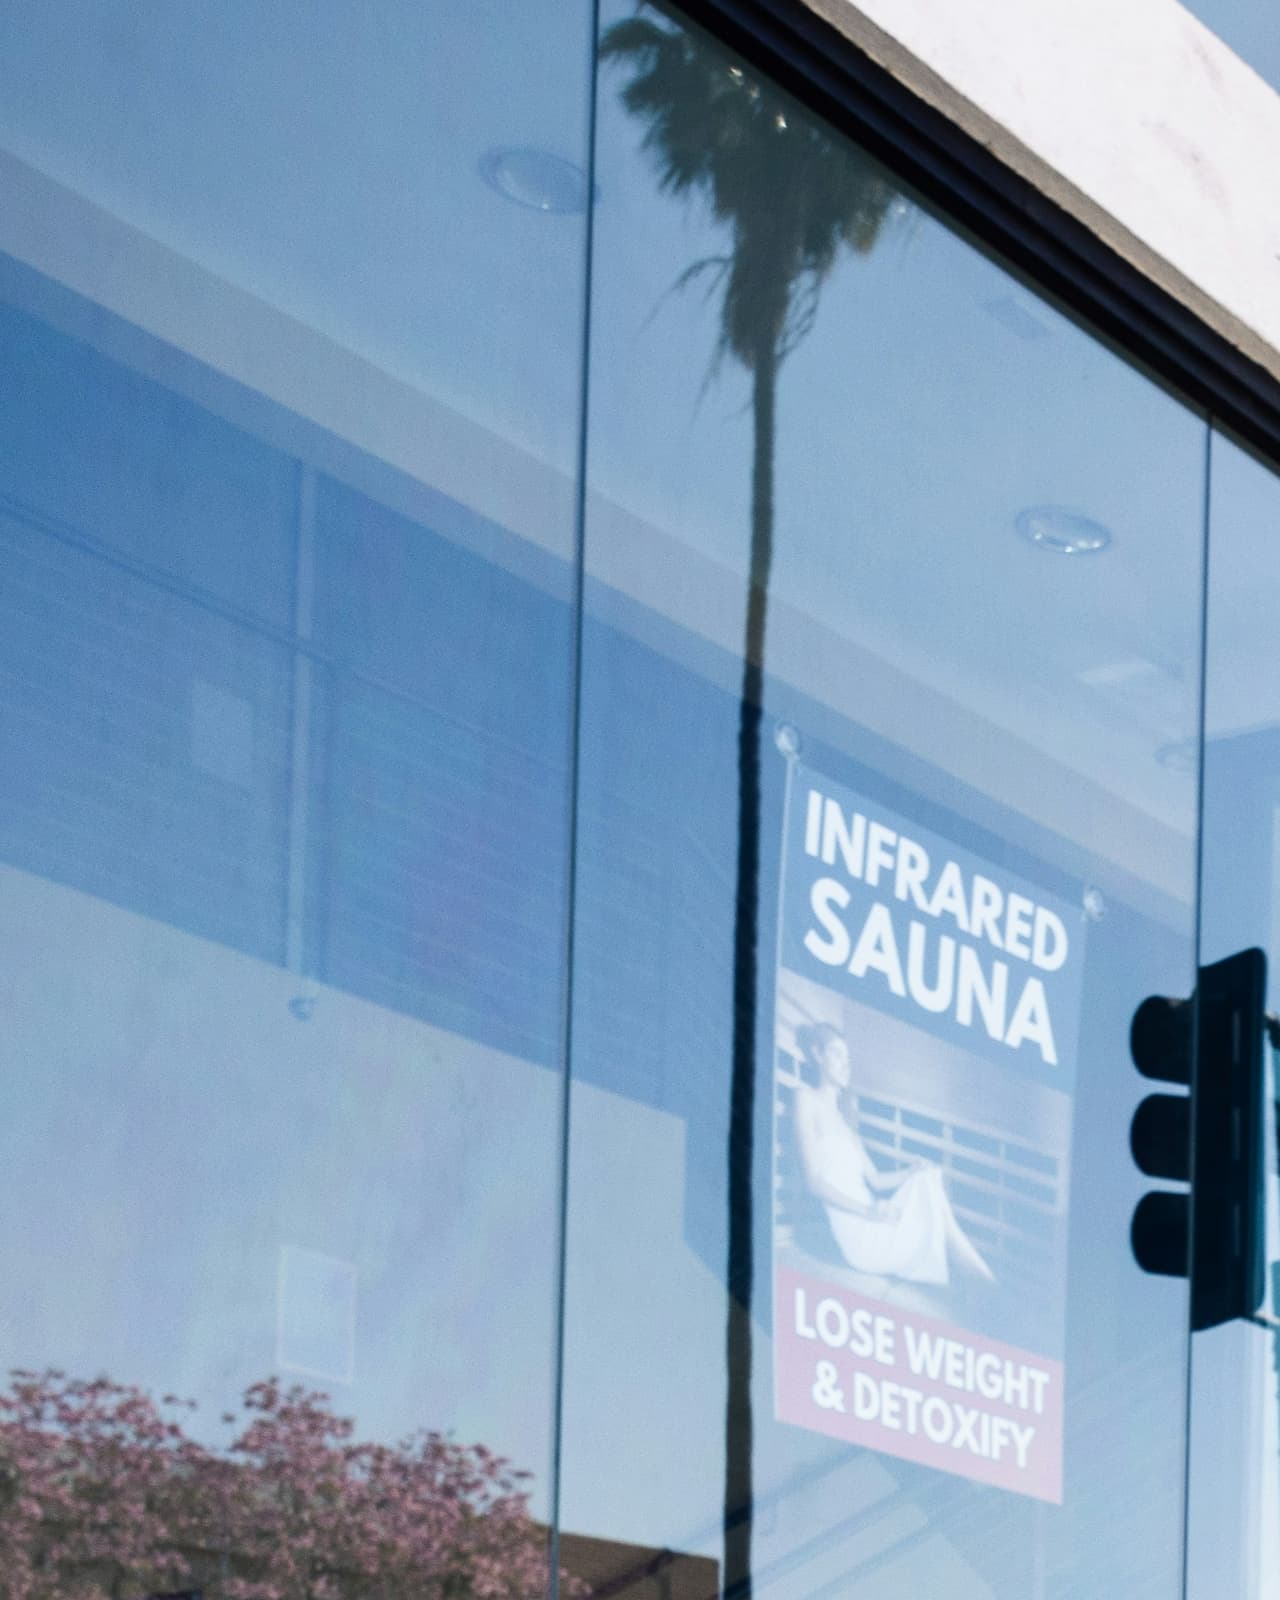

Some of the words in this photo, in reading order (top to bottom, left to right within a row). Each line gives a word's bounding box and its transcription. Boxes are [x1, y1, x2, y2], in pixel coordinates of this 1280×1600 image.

[805, 789, 1068, 971] INFRARED
[804, 877, 1058, 1066] SAUNA
[794, 1288, 895, 1365] LOSE
[904, 1325, 1049, 1414] WEIGHT
[812, 1360, 846, 1413] &
[853, 1372, 1036, 1468] DETOXIFY
